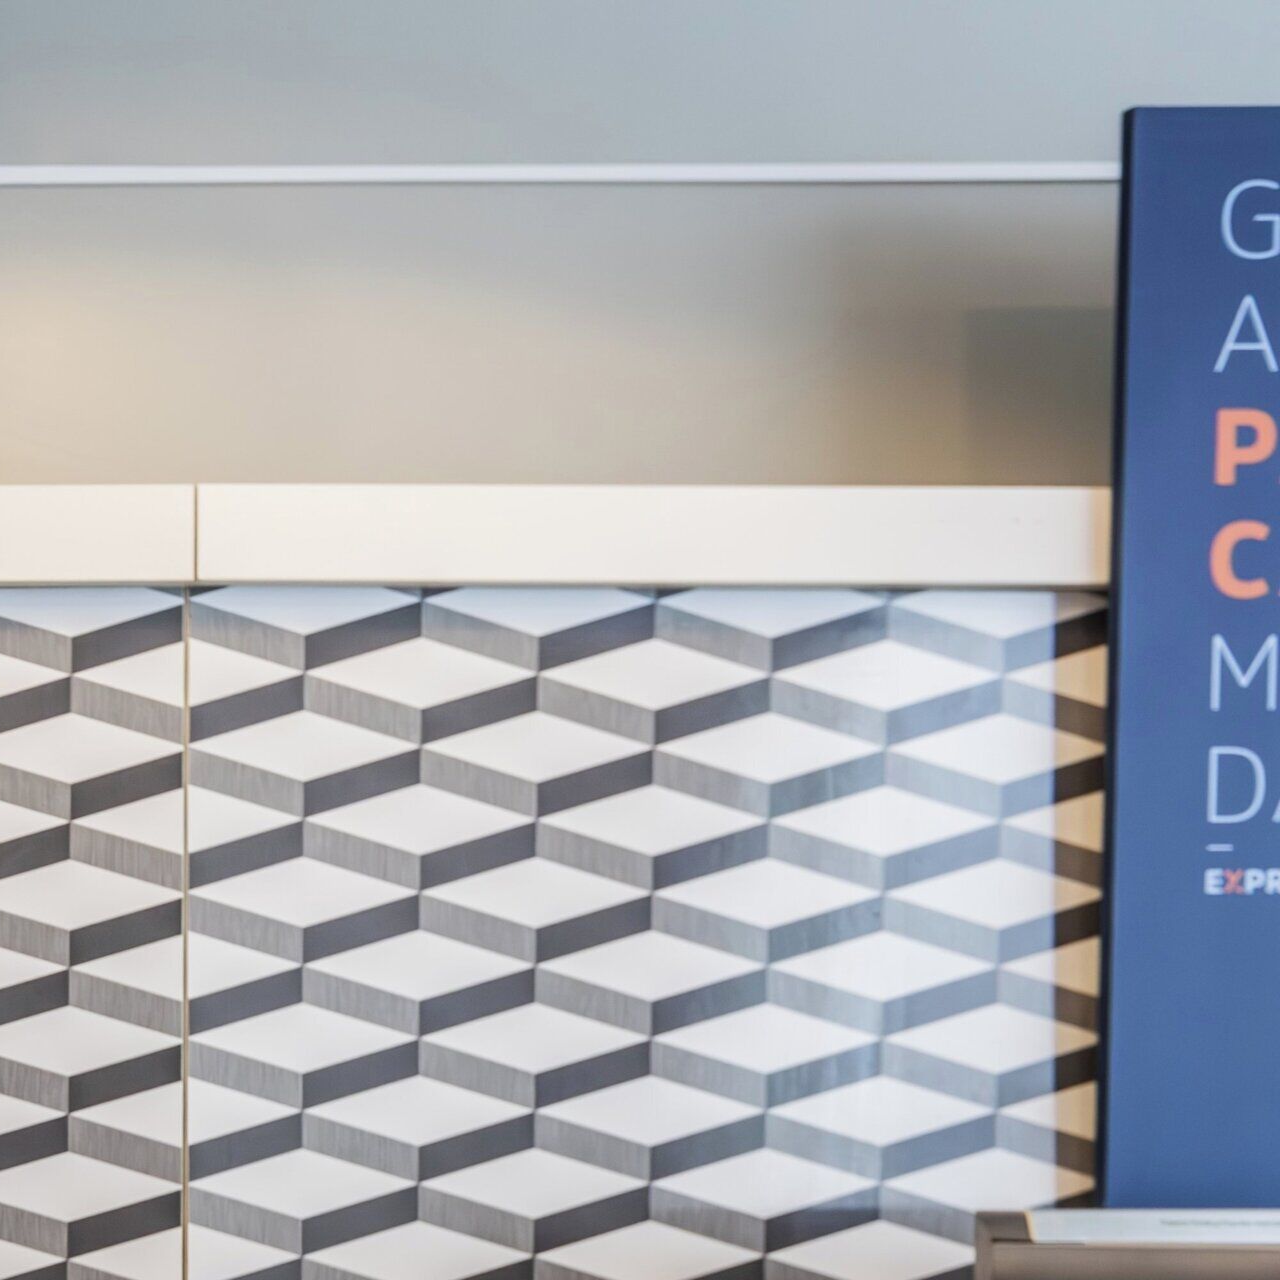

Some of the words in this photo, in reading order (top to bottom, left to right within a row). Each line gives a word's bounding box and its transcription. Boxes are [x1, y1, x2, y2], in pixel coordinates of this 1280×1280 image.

[1220, 178, 1280, 260] G
[1213, 294, 1279, 373] A
[1214, 407, 1280, 486] P
[1209, 519, 1280, 600] C
[1209, 633, 1280, 713] M
[1206, 745, 1280, 824] D
